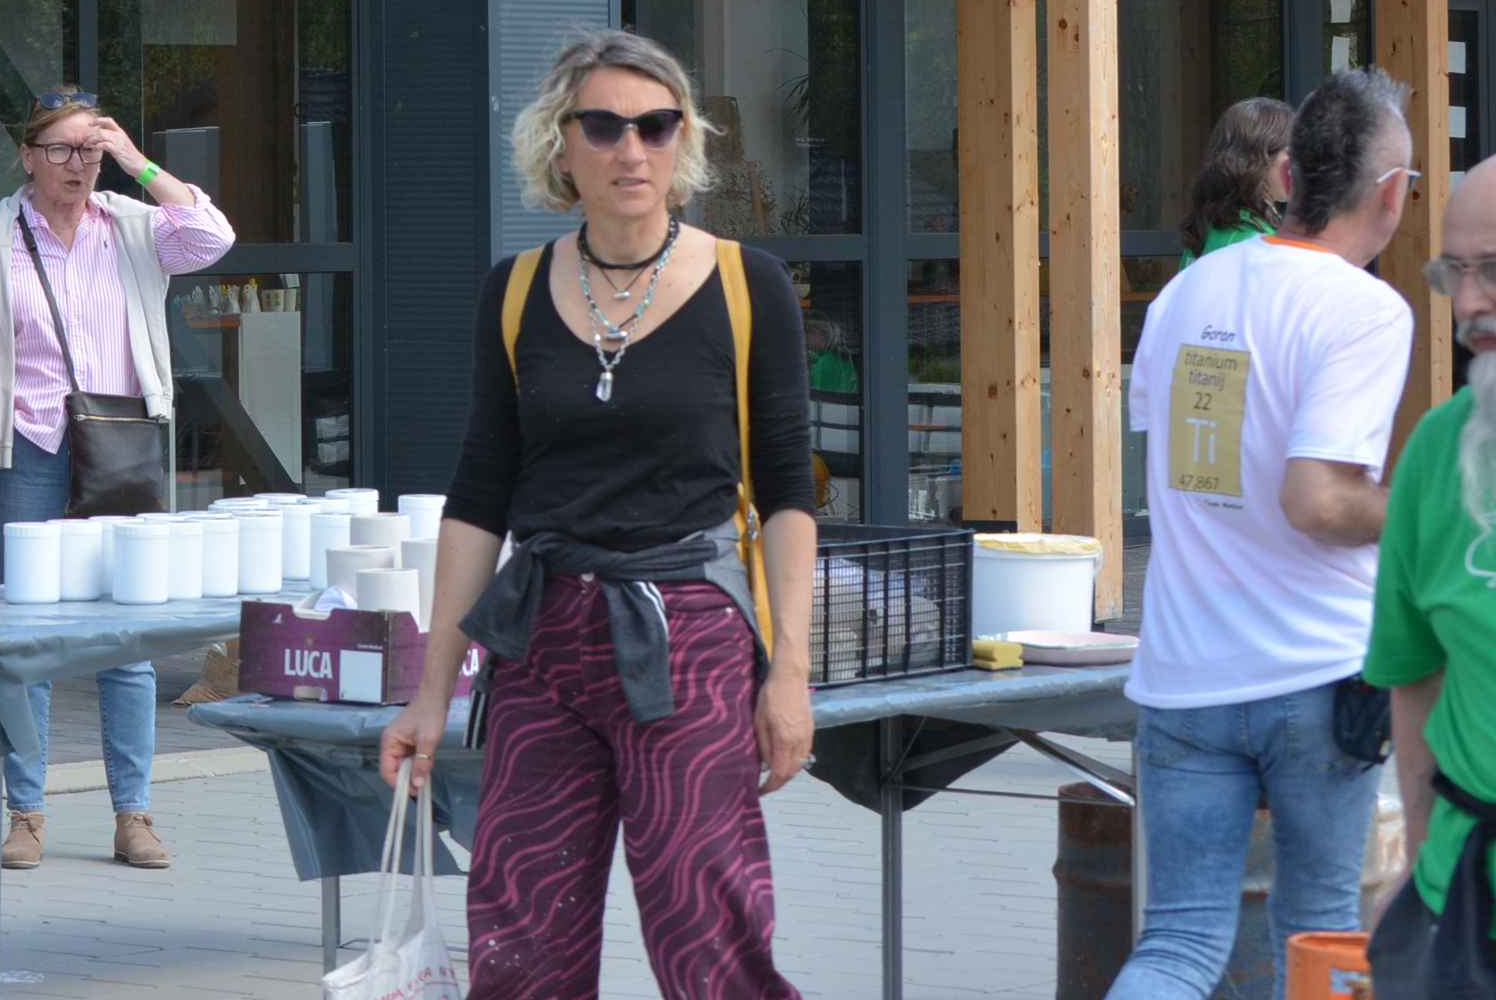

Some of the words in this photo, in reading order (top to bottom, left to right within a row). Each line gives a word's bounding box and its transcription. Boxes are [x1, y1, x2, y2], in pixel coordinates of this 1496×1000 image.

[1184, 351, 1240, 372] titanium
[1193, 391, 1213, 410] 22
[1185, 417, 1217, 465] Ti
[284, 648, 334, 679] LUCA
